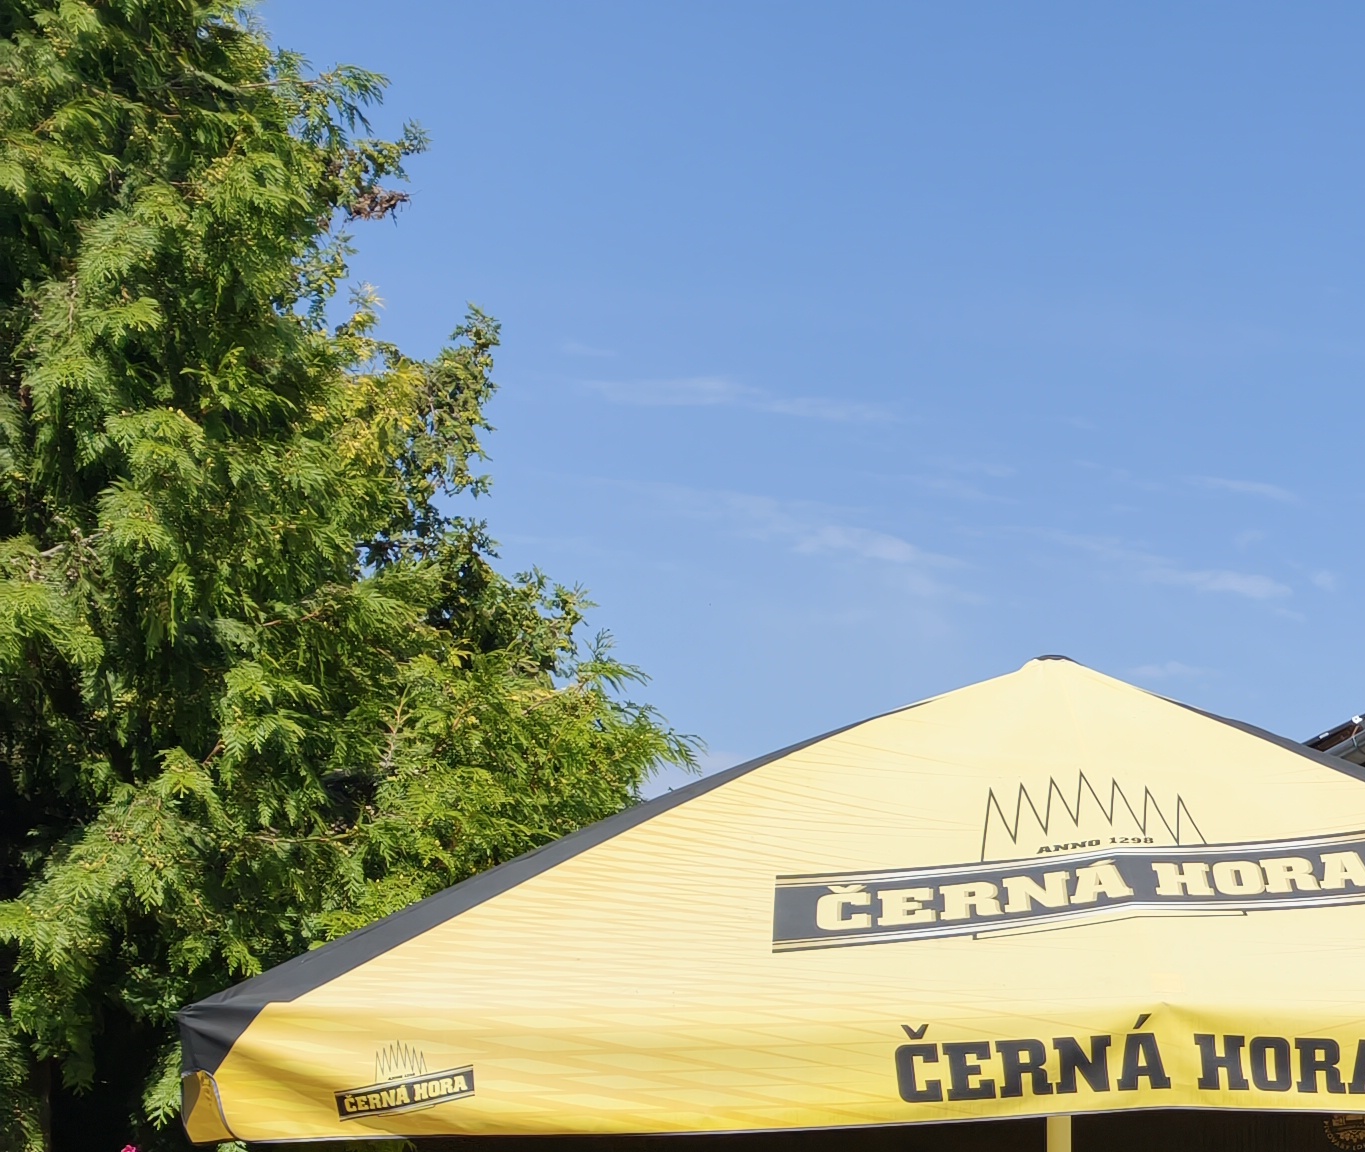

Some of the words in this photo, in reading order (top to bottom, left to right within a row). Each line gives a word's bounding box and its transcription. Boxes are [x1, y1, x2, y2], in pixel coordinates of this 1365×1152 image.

[1036, 839, 1101, 854] ANNO
[1108, 836, 1155, 844] 1298
[815, 859, 1134, 932] ČERNÁ
[895, 1013, 1172, 1104] ČERNÁ
[344, 1084, 411, 1114] ČERNÁ
[413, 1074, 469, 1102] HORA
